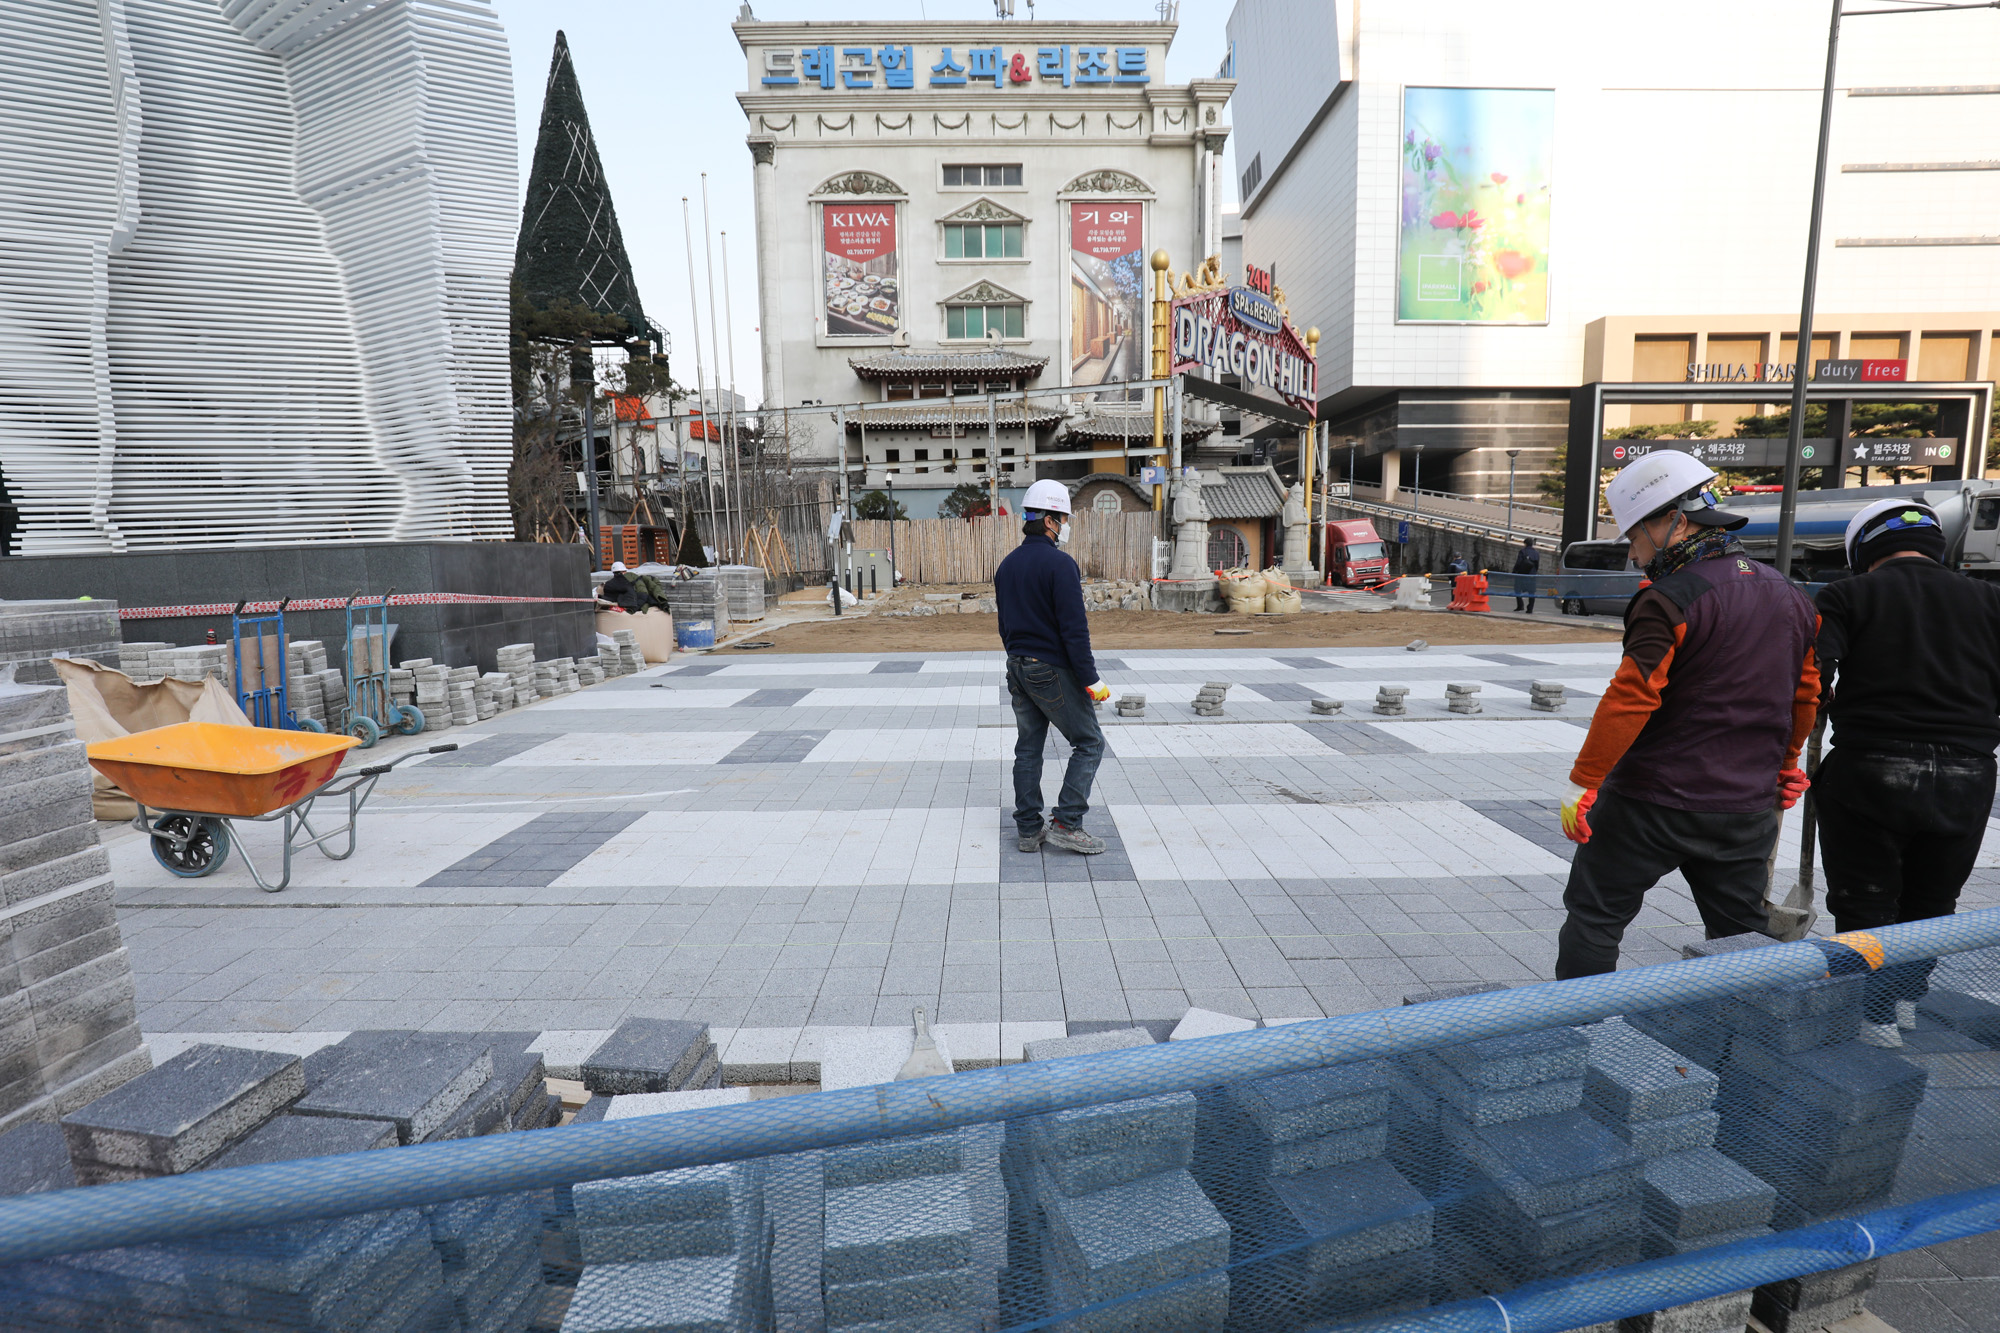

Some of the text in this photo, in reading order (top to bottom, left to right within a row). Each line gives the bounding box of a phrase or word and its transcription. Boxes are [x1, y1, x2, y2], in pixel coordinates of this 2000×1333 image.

[761, 44, 1150, 88] 드래곤힐 스파&리조트
[831, 212, 890, 227] KIWA
[1247, 264, 1270, 295] 24H
[1178, 307, 1317, 401] DRAGON HILL
[1686, 362, 1796, 379] SHILLA IPAR
[1821, 362, 1900, 381] duty free
[1628, 446, 1652, 455] OUT
[1708, 443, 1746, 455] 해주차장
[1873, 443, 1912, 455] 별주차장
[1924, 446, 1936, 456] IN
[1144, 468, 1156, 482] P
